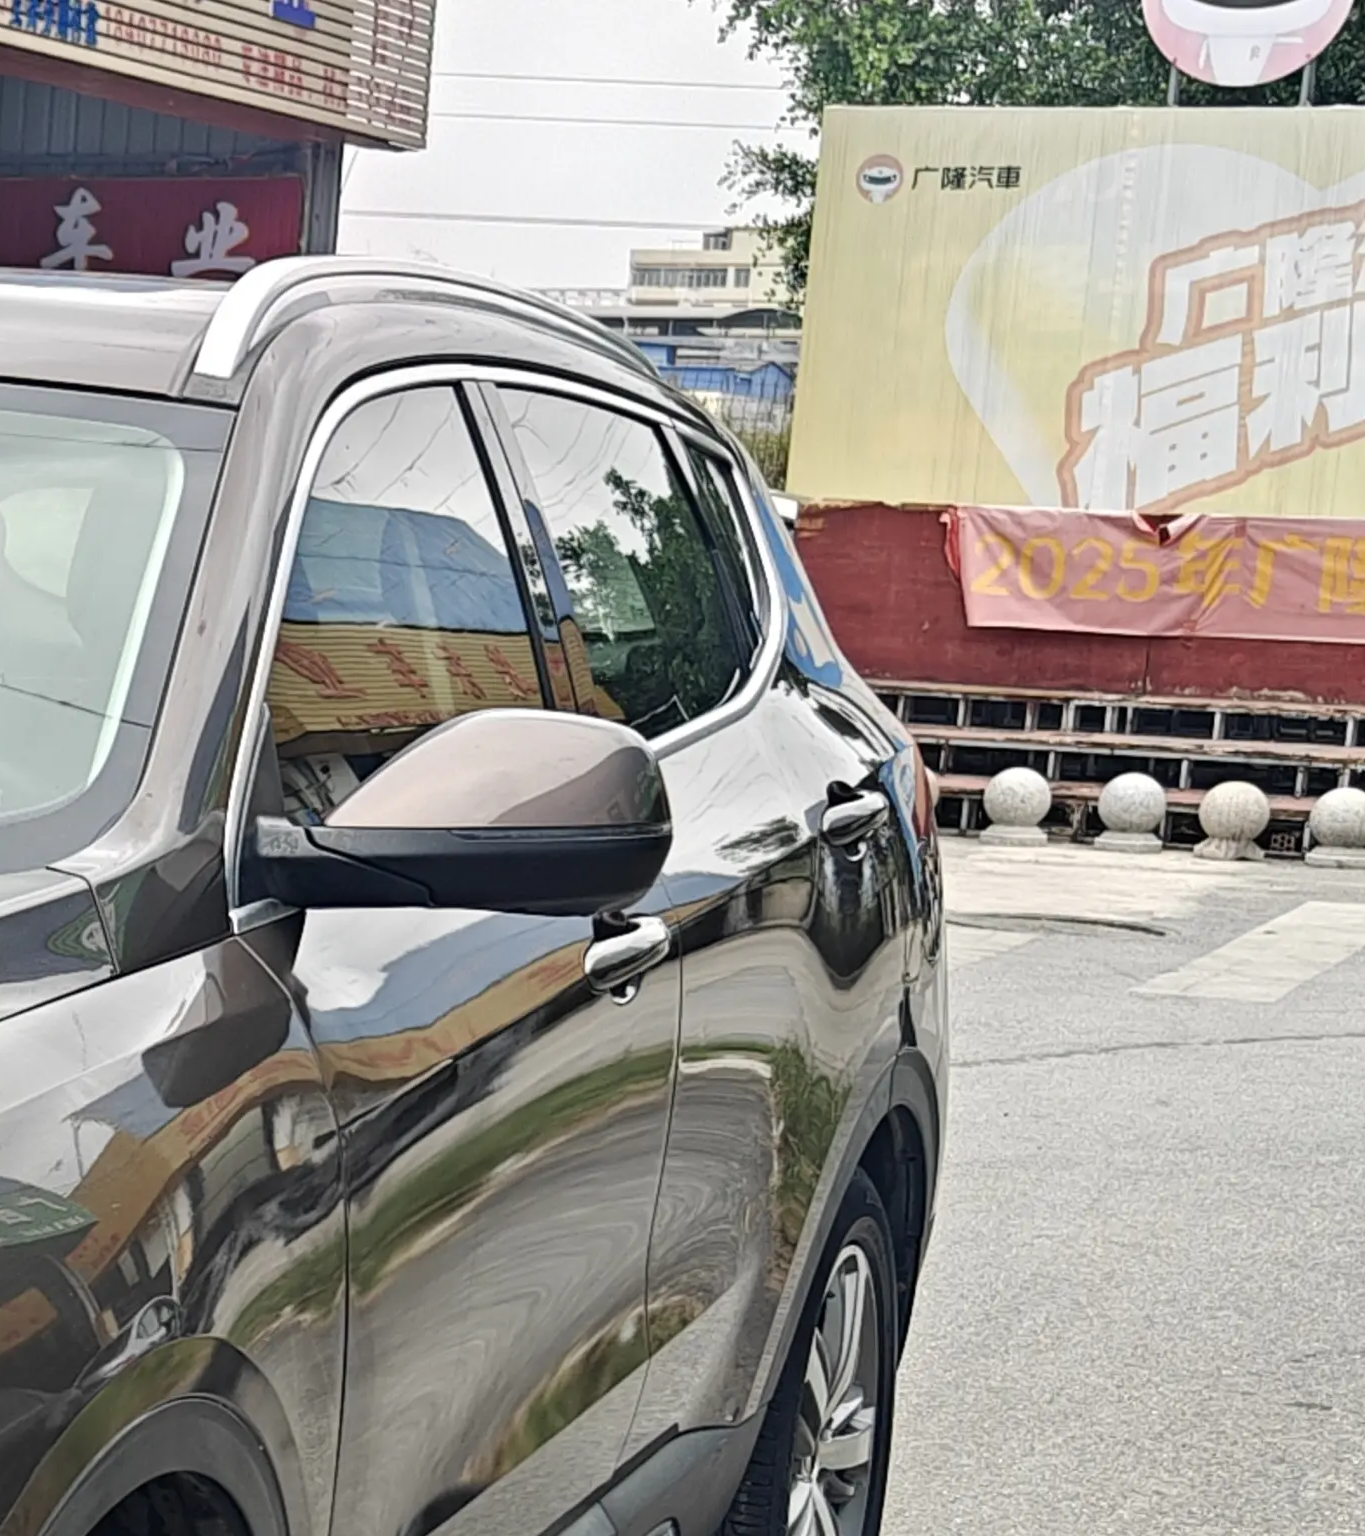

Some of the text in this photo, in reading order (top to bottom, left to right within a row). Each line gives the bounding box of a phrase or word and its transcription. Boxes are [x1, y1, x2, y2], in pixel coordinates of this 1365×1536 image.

[910, 165, 1022, 191] 广隆汽車
[1157, 214, 1365, 346] 广隆
